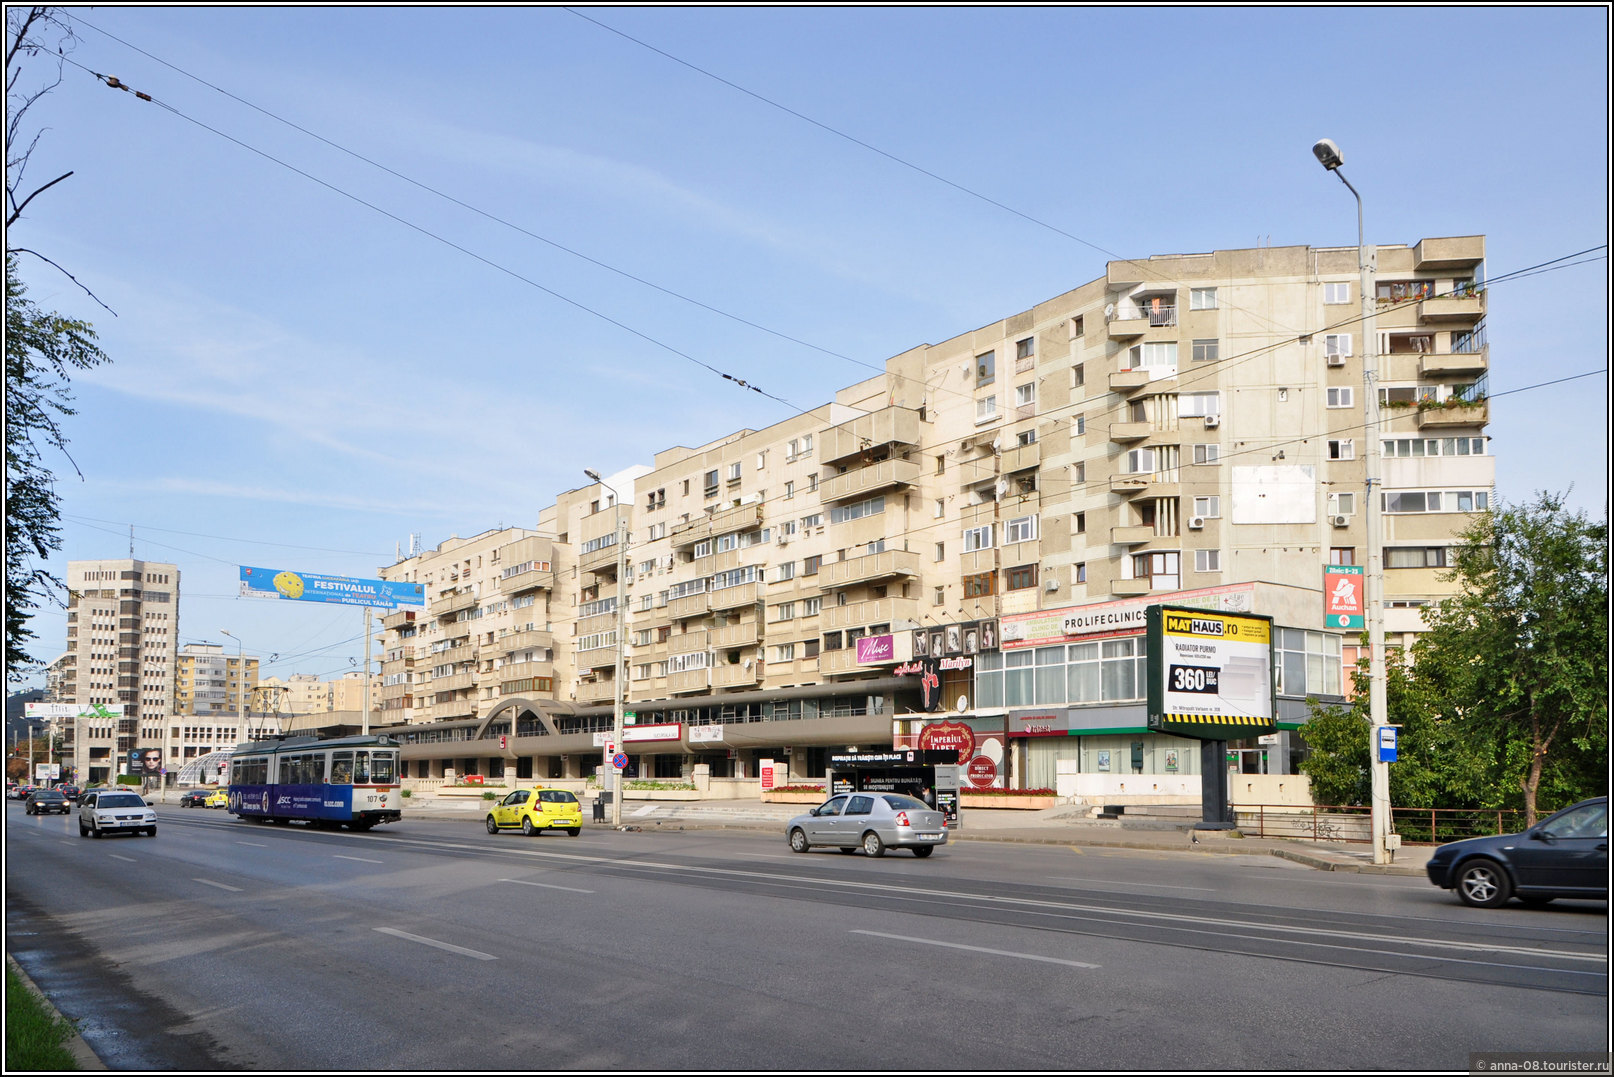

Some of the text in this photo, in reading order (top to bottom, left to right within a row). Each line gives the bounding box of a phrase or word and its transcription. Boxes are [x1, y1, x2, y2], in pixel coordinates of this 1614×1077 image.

[314, 580, 376, 594] FESTIVALUL
[352, 592, 376, 600] TEATRU
[1107, 610, 1148, 624] CLINICS
[861, 639, 889, 659] Muse
[1175, 643, 1216, 654] RADIATOR PURMO
[939, 656, 972, 670] Marilyn
[1174, 668, 1205, 690] 360
[367, 795, 378, 803] 107
